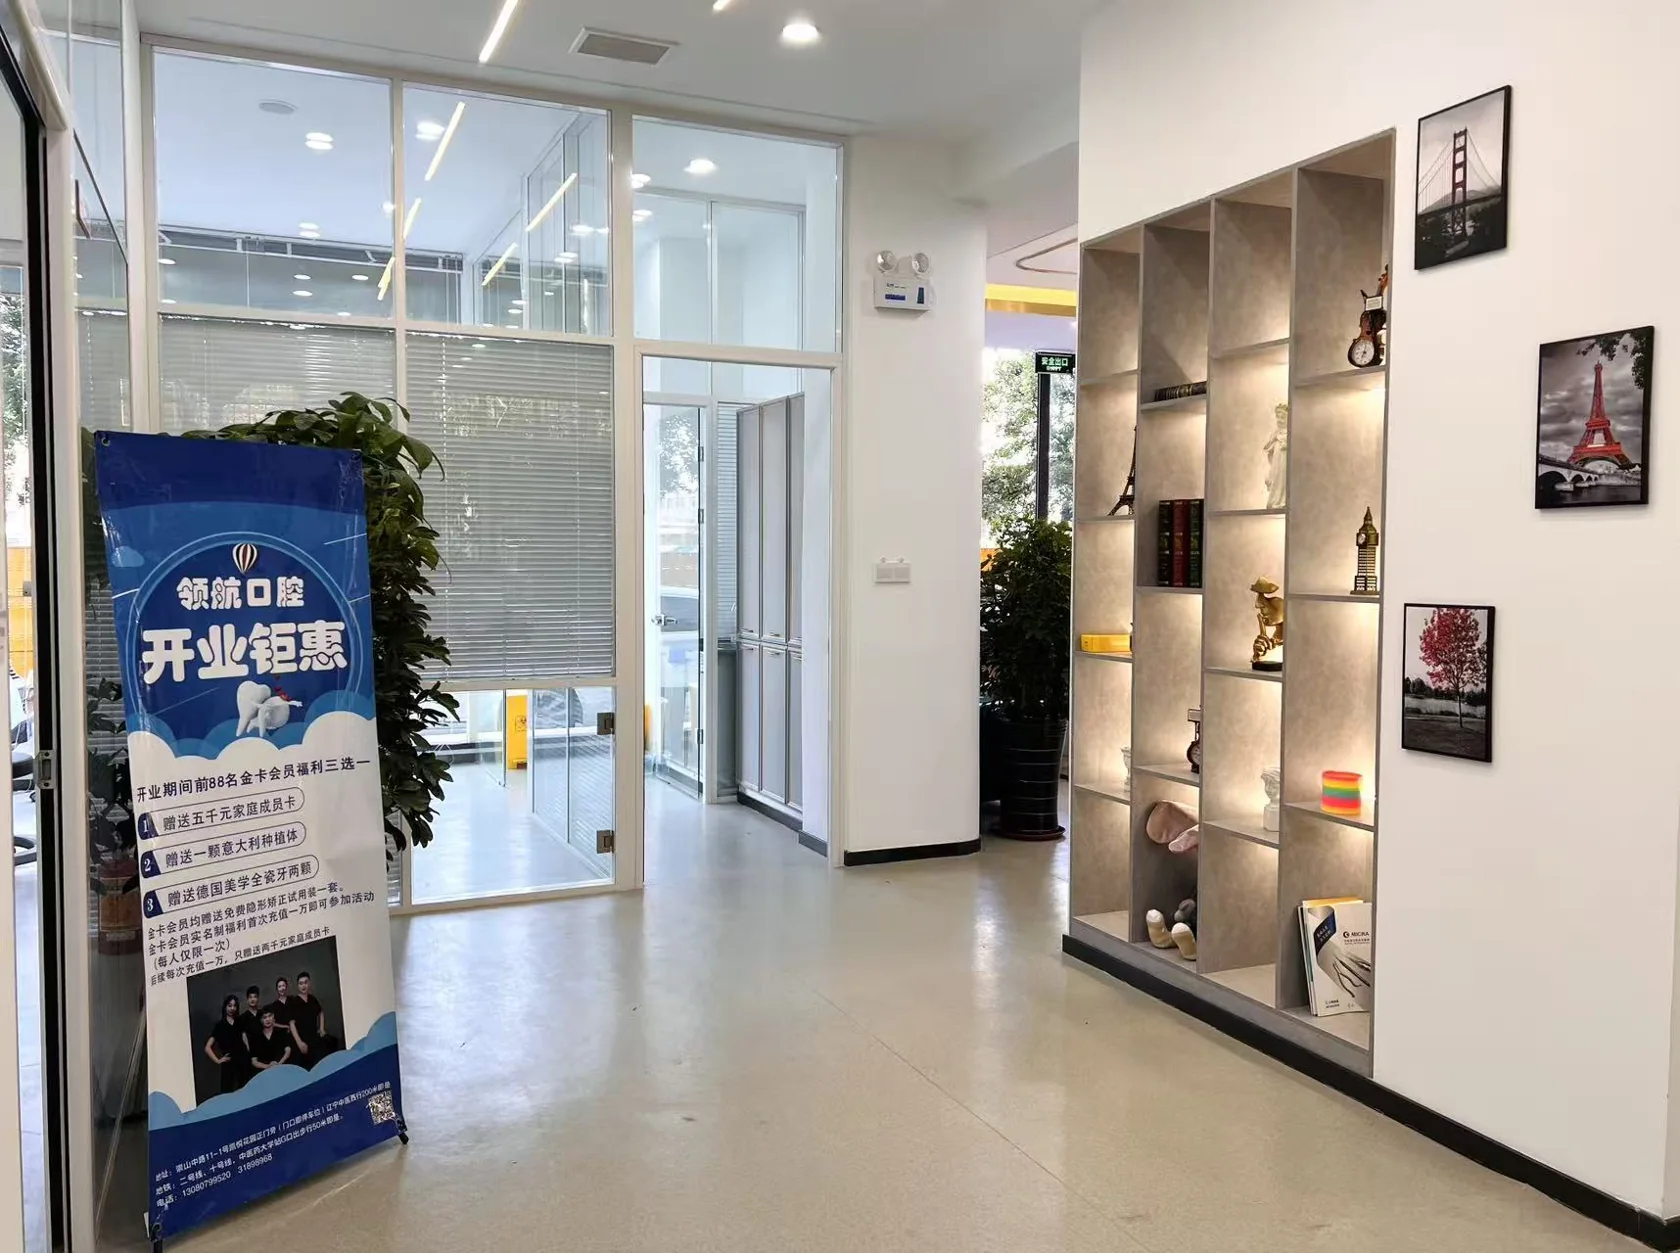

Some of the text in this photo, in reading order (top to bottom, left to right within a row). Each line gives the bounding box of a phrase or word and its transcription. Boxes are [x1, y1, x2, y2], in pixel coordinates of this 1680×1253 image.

[1041, 357, 1068, 366] 安全出口
[176, 576, 305, 611] 领航口腔
[142, 619, 348, 685] 开业钜惠
[136, 757, 371, 803] 开业期间前88名金卡会员福利三选一
[163, 795, 297, 832] 赠送五千元家庭成员卡
[165, 828, 298, 869] 赠送一颗意大利种植体
[167, 861, 312, 907] 赠送德国美学全瓷牙两颗
[149, 891, 375, 956] 金卡会员实名制福利首次充值一万即可参加活动
